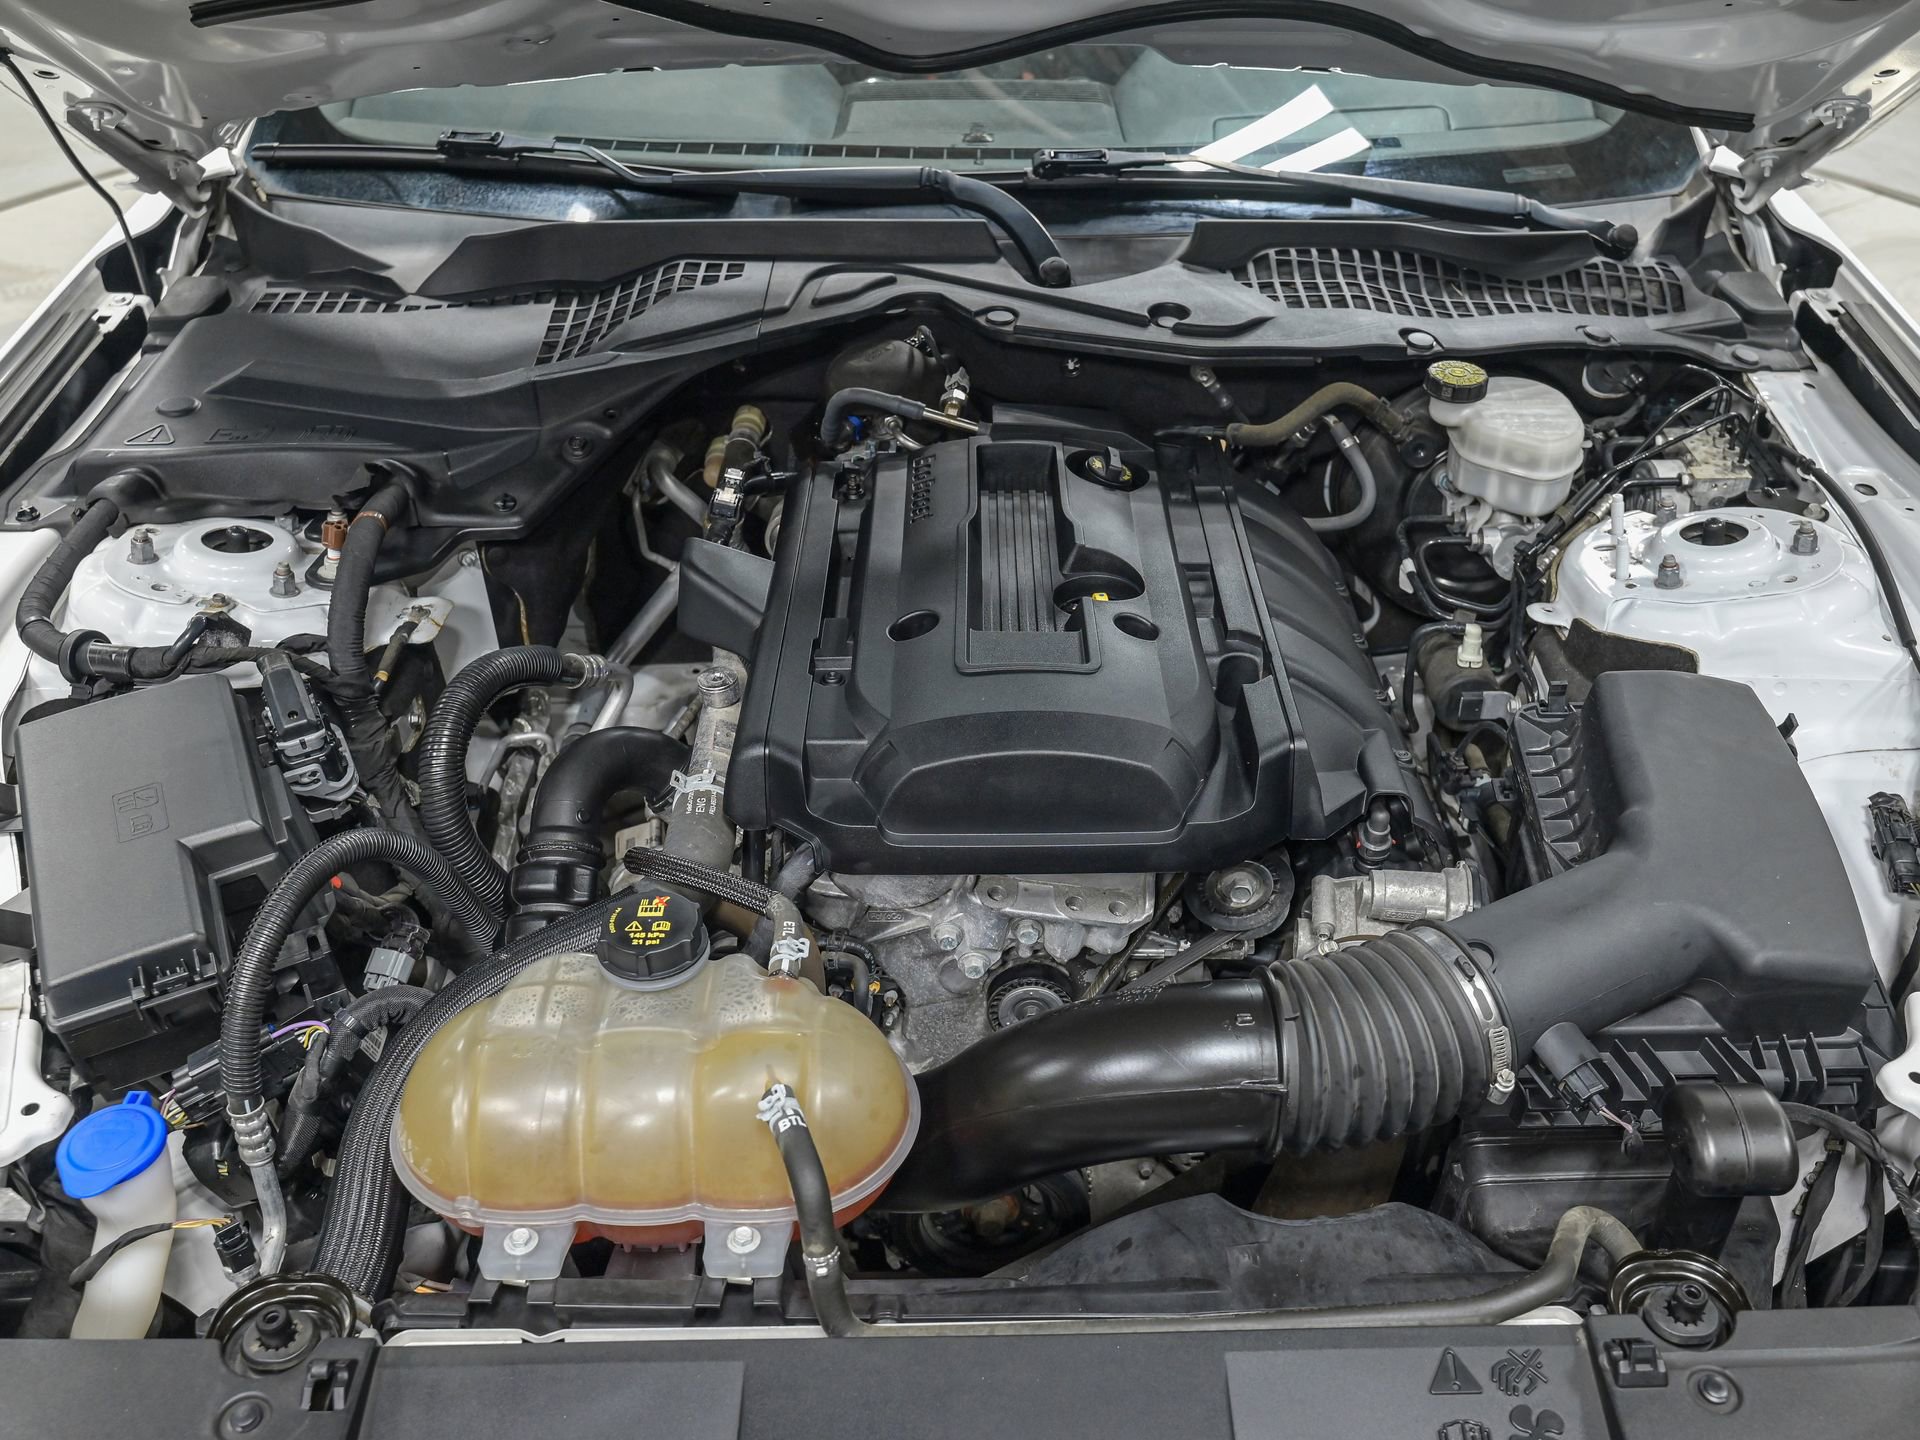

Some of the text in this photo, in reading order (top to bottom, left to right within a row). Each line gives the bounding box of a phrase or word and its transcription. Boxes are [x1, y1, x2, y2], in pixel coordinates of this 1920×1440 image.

[695, 797, 707, 813] ENG
[782, 920, 796, 937] ETL
[777, 1115, 807, 1133] BTL
